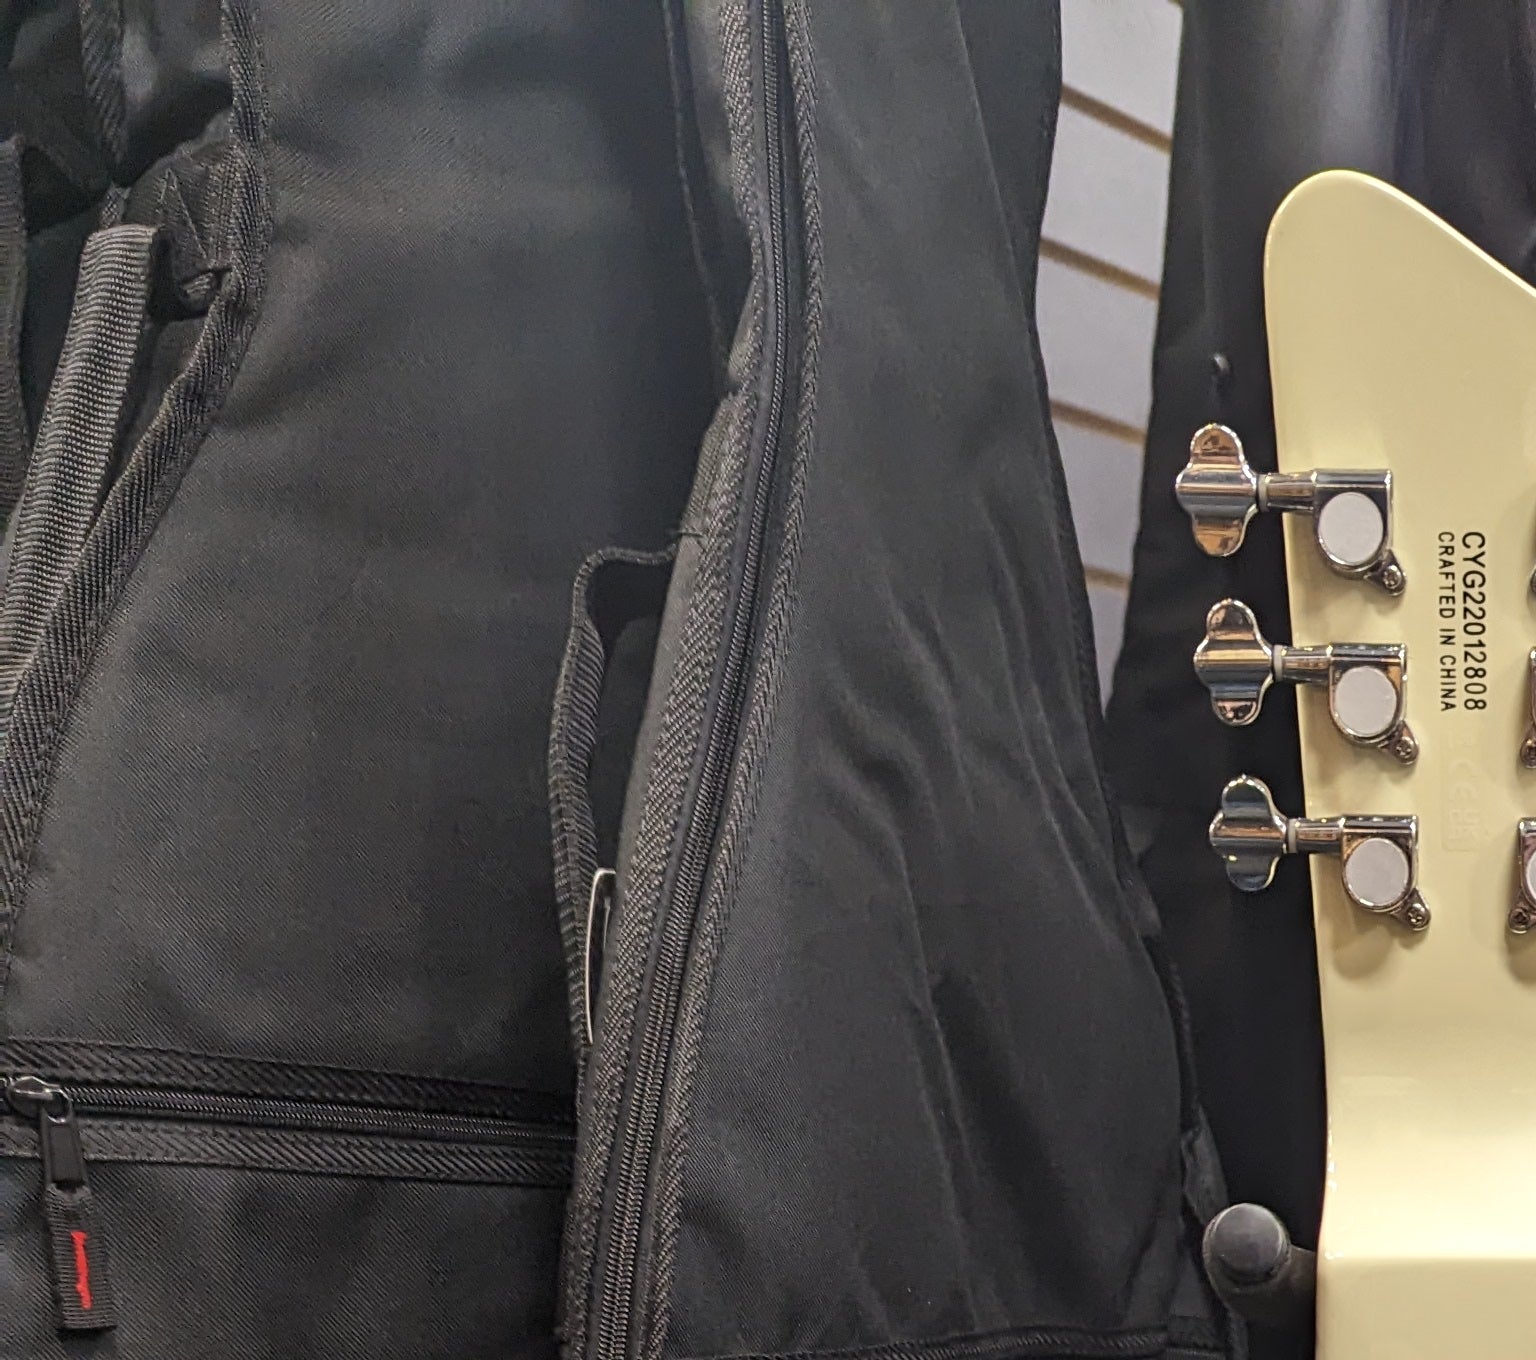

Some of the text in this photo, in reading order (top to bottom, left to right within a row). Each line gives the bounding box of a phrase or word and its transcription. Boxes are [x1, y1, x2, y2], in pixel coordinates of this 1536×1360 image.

[1438, 531, 1456, 712] CRAFTED IN CHINA
[1462, 531, 1486, 710] CYG22012808
